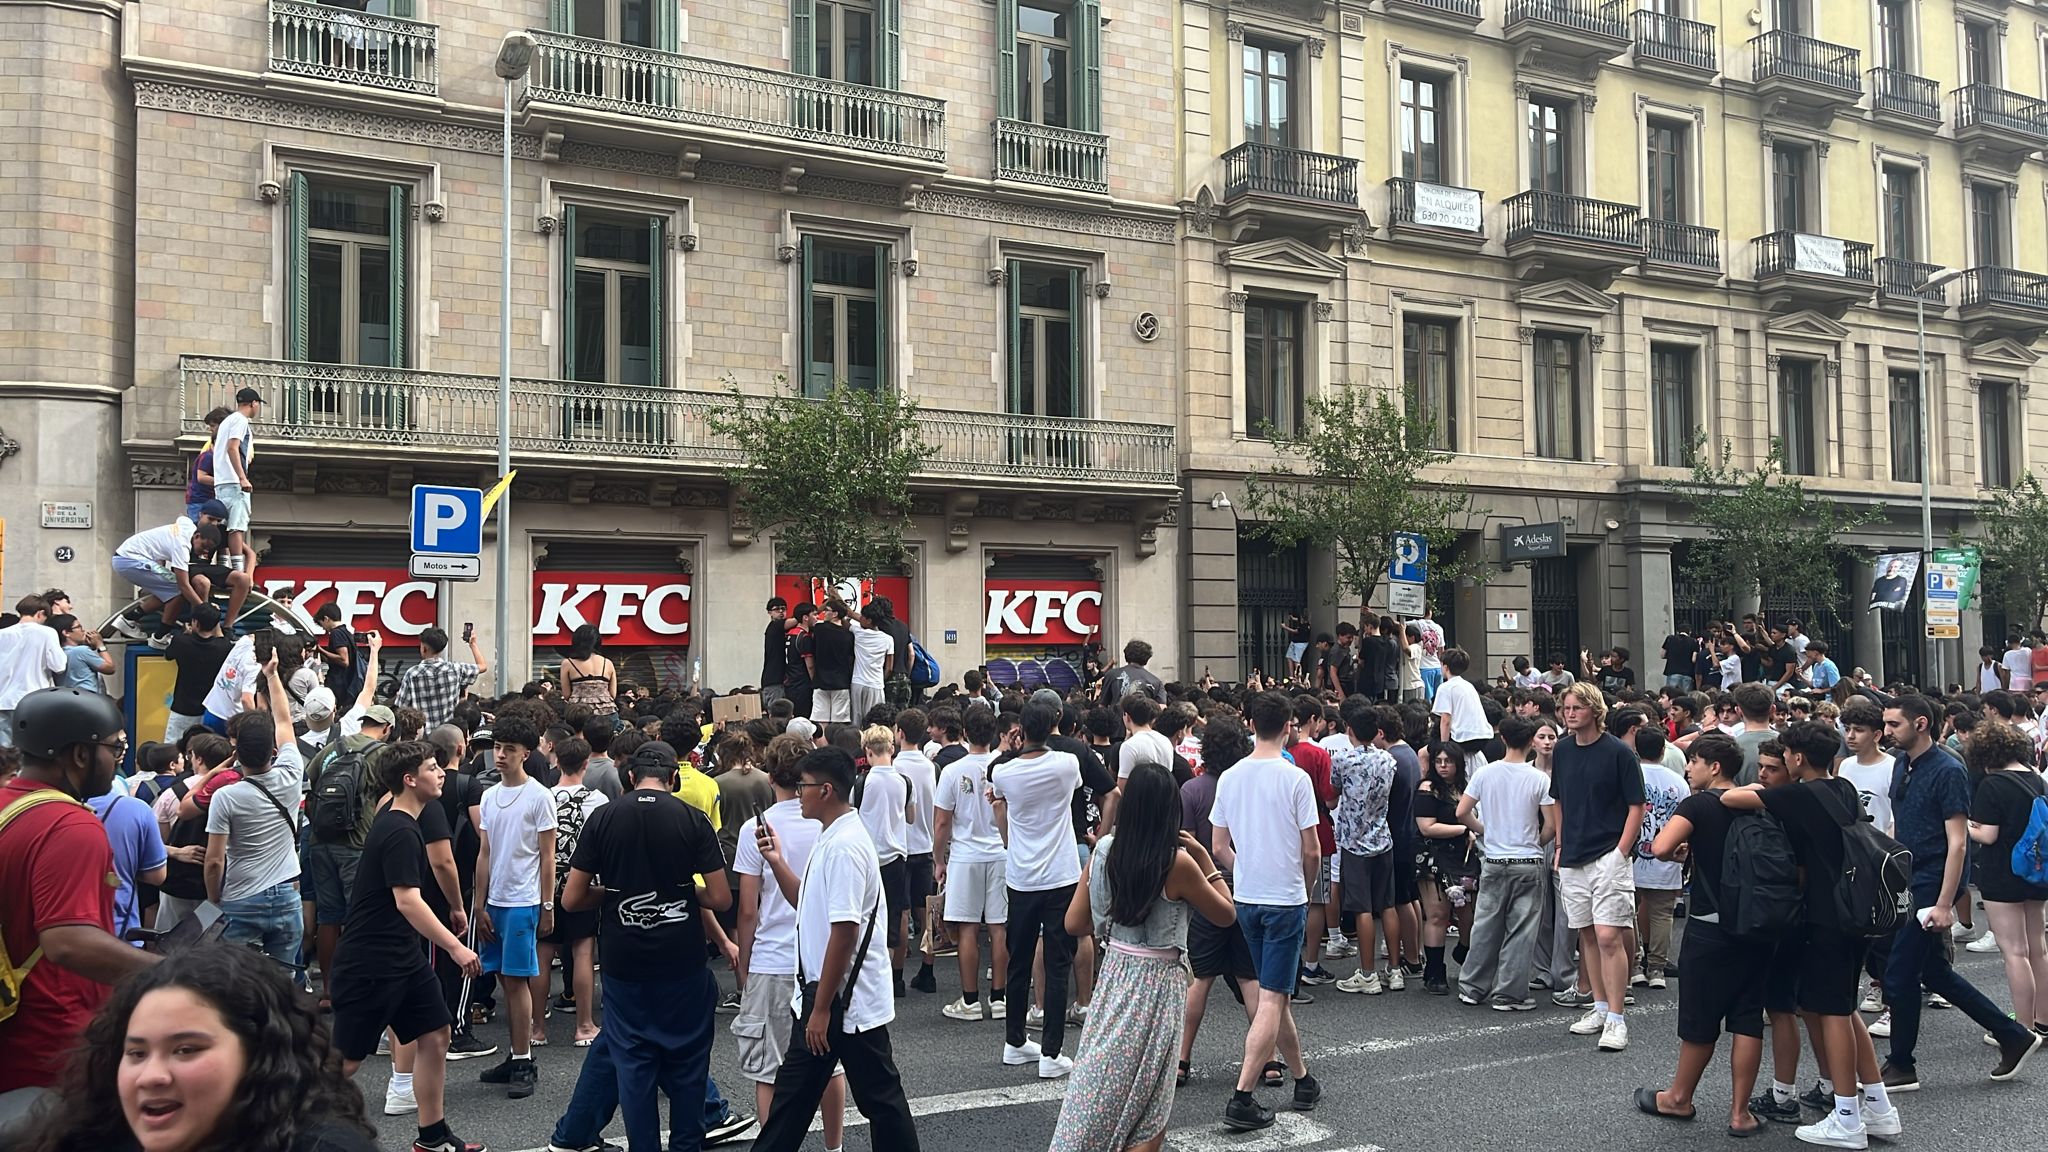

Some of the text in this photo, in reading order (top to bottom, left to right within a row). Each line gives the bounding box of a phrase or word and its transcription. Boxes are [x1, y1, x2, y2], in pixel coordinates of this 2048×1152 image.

[1421, 196, 1474, 213] EN ALQUILER
[1422, 210, 1475, 227] 630 20 24 22
[423, 493, 467, 547] P
[1525, 533, 1553, 545] Adeslas
[57, 548, 72, 560] 24
[1395, 536, 1419, 576] P
[423, 561, 448, 570] Motos
[1930, 574, 1939, 588] P
[263, 580, 437, 636] KFC
[533, 583, 690, 635] KFC
[985, 590, 1102, 635] KFC
